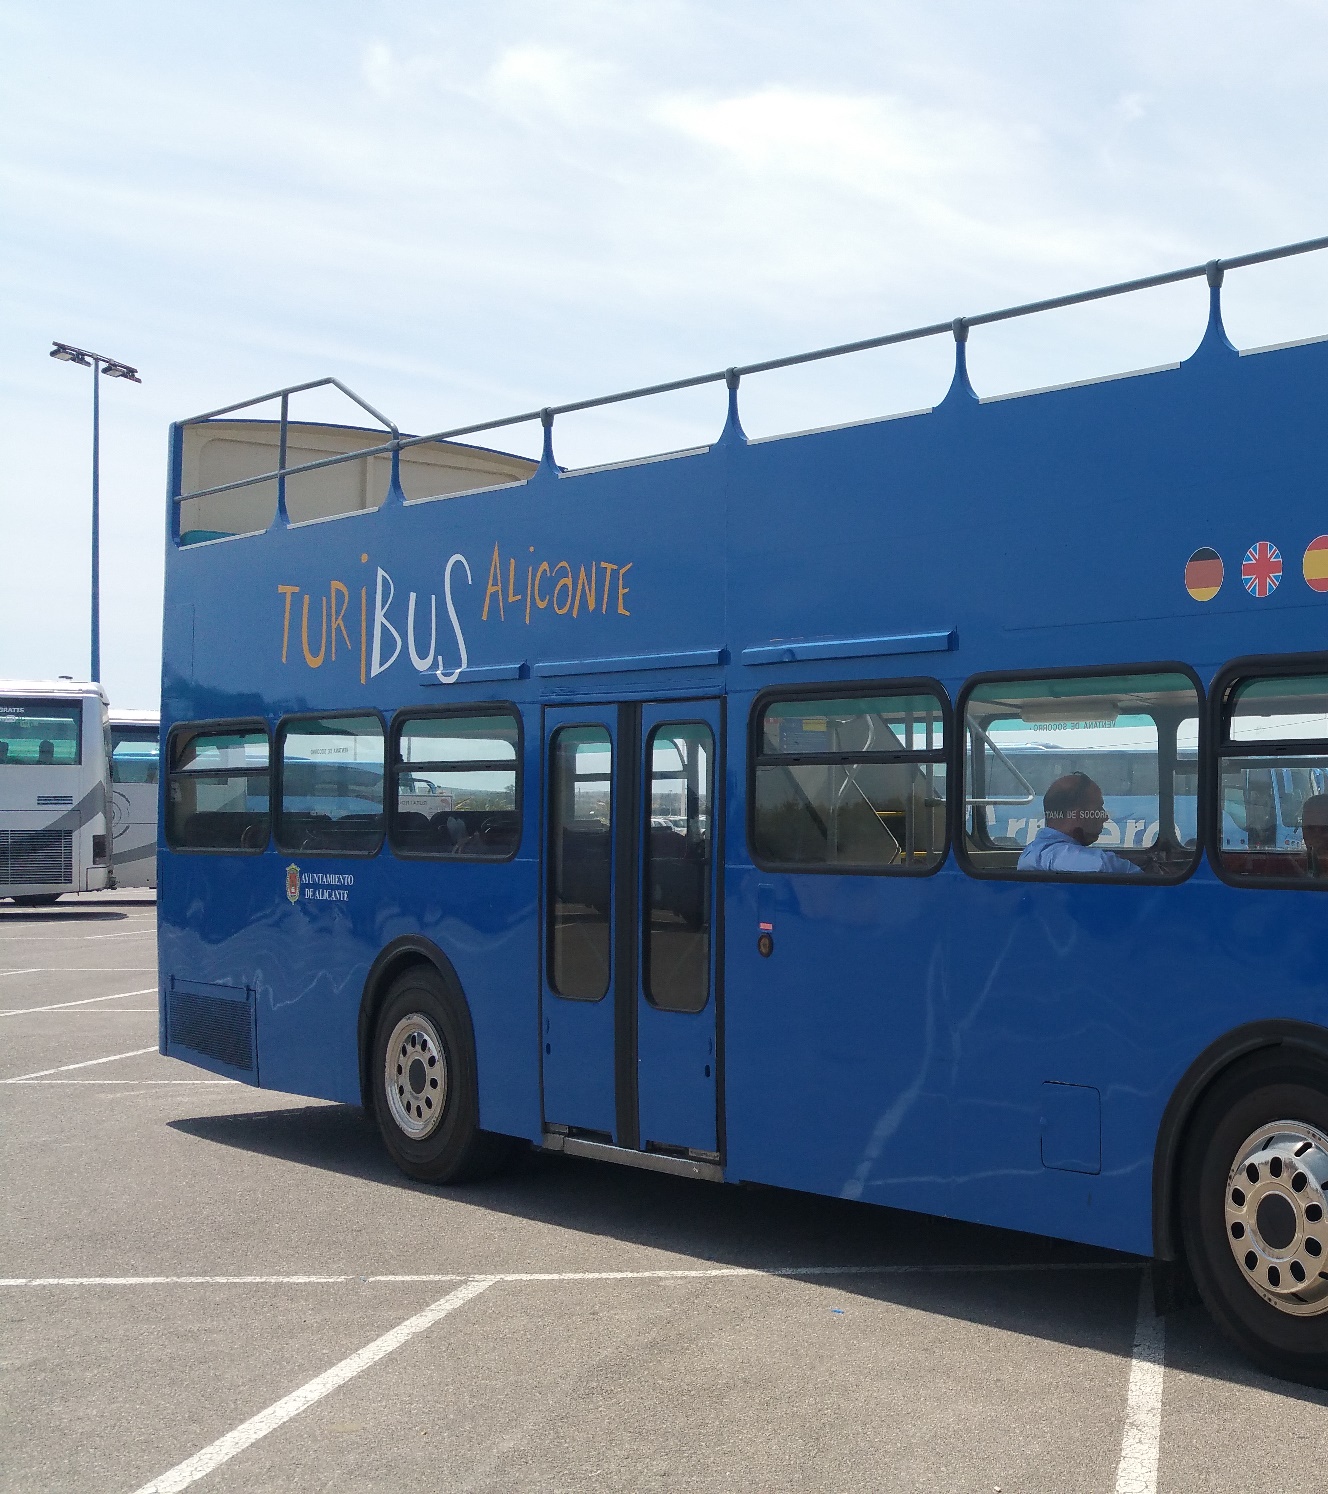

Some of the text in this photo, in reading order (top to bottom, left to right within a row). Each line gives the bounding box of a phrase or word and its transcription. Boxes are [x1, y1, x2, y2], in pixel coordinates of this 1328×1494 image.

[301, 873, 354, 885] AYUNTAMIENTO
[304, 888, 349, 901] DE ALICANTE
